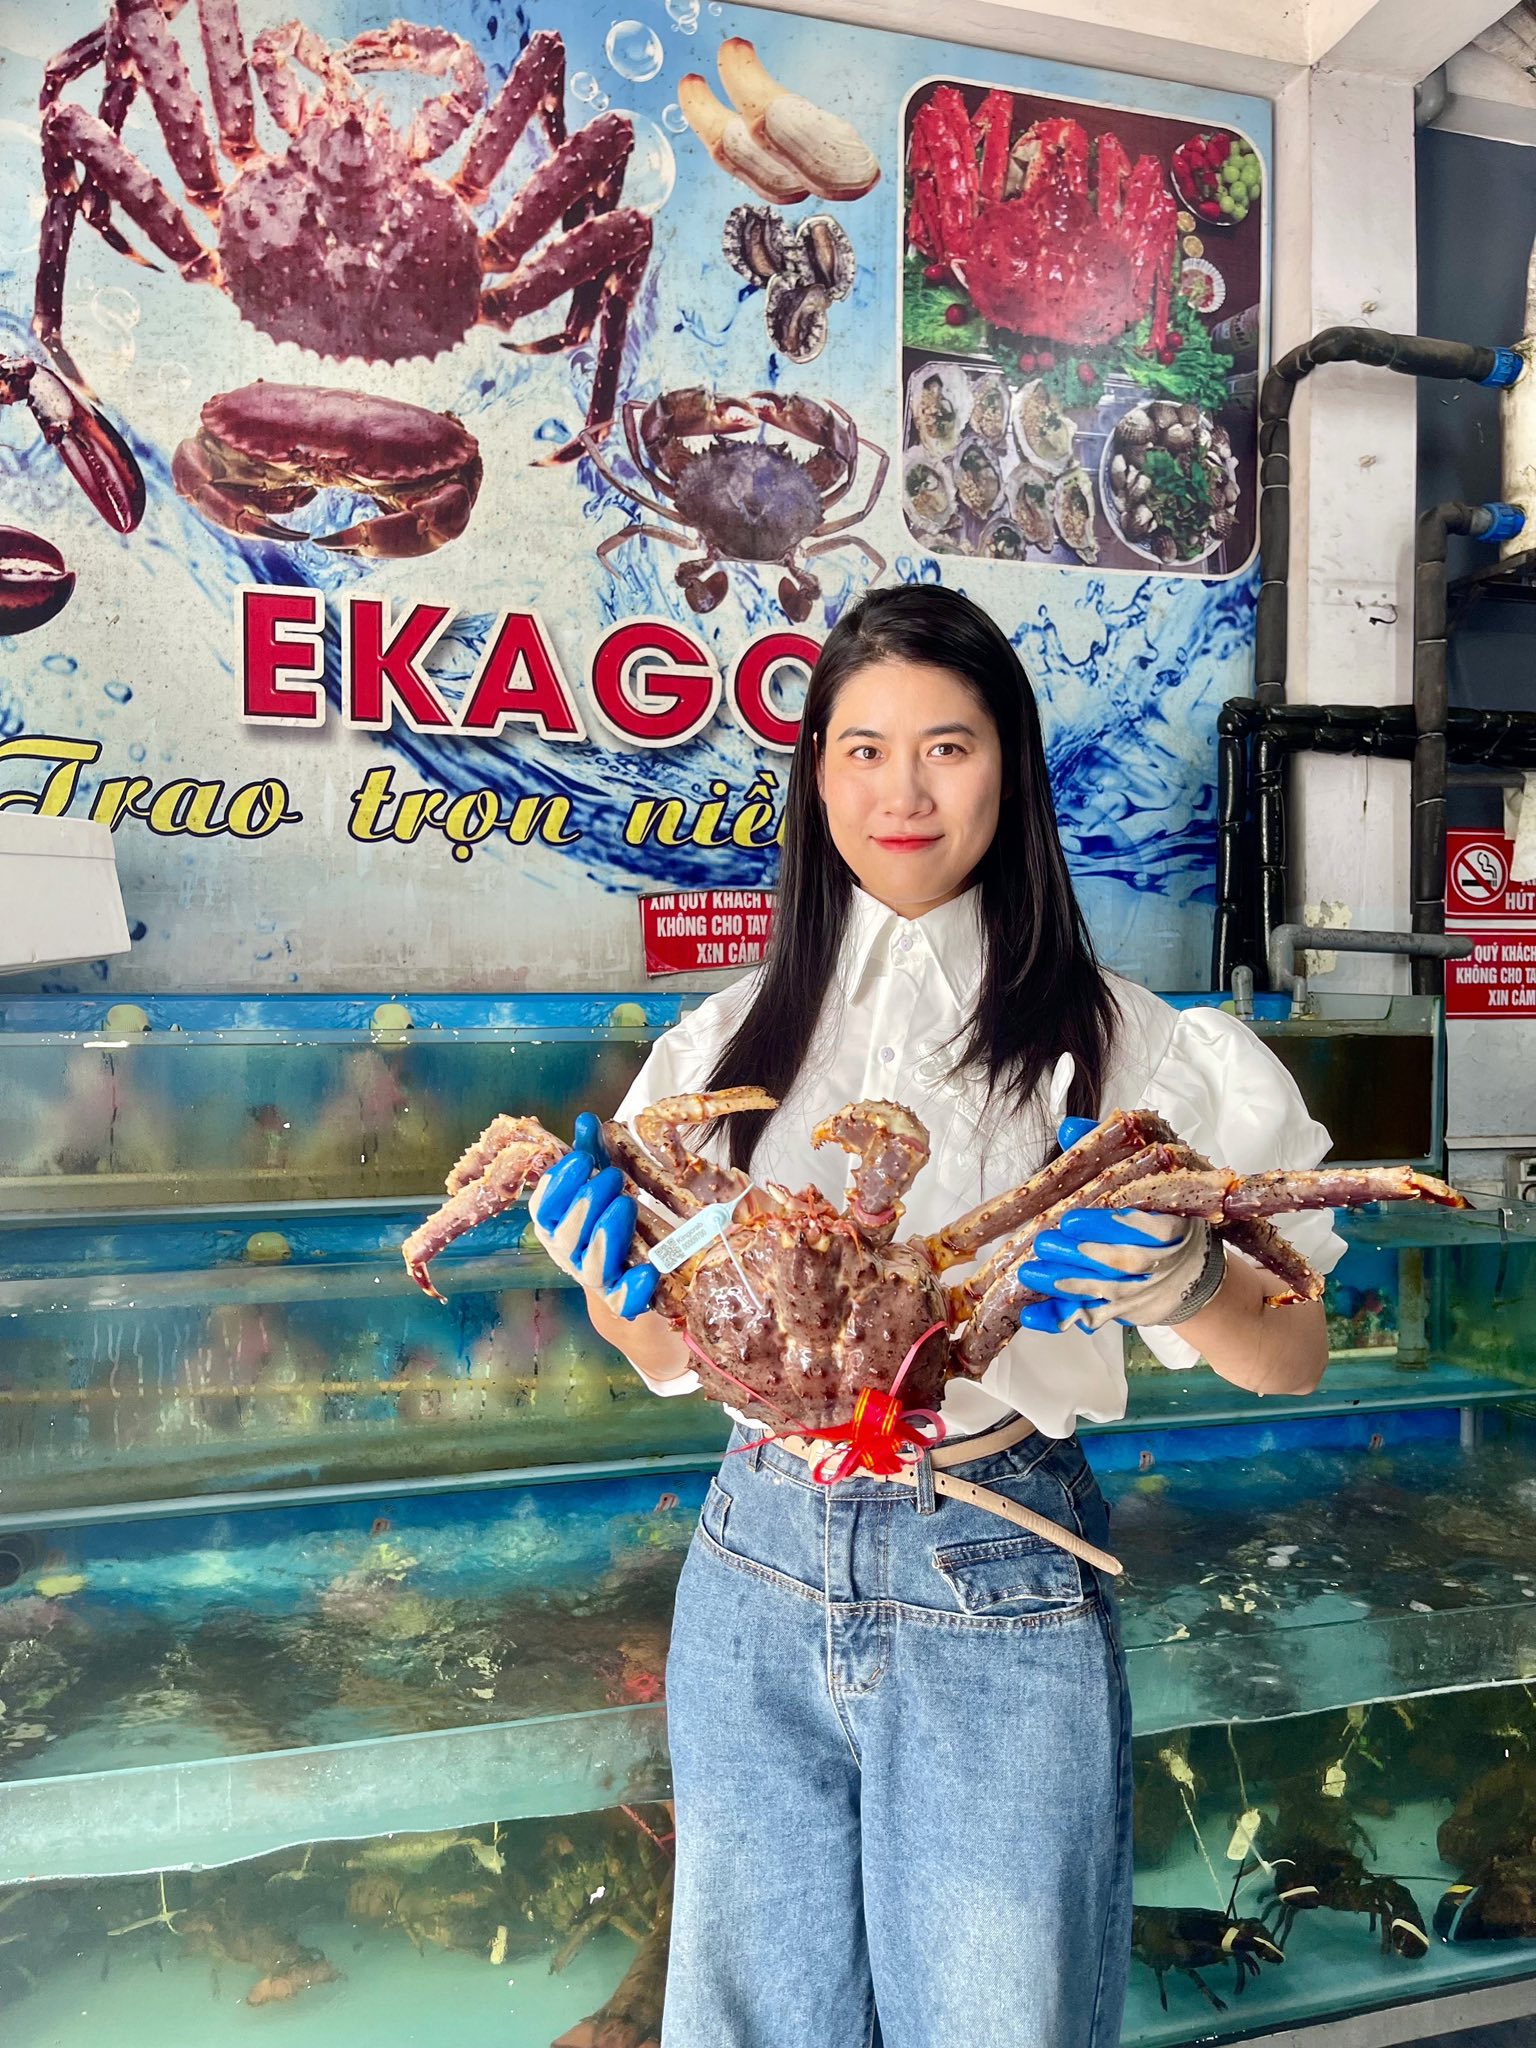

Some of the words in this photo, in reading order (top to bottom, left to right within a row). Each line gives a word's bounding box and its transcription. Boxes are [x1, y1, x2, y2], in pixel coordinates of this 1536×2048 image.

[0, 734, 303, 838] Trao
[348, 765, 580, 863] trọn
[622, 770, 785, 849] niề
[1505, 888, 1536, 910] HÚT
[656, 911, 707, 937] KHÔNG
[711, 914, 742, 936] CHO
[745, 914, 768, 935] TAY
[696, 942, 723, 964] XIN
[728, 935, 760, 963] CẢM
[1474, 941, 1499, 963] QUÝ
[1501, 941, 1536, 962] KHÁCH
[1456, 963, 1498, 984] KHÔNG
[1500, 967, 1523, 984] CHO
[1488, 989, 1509, 1006] XIN
[1511, 984, 1536, 1006] CẢM
